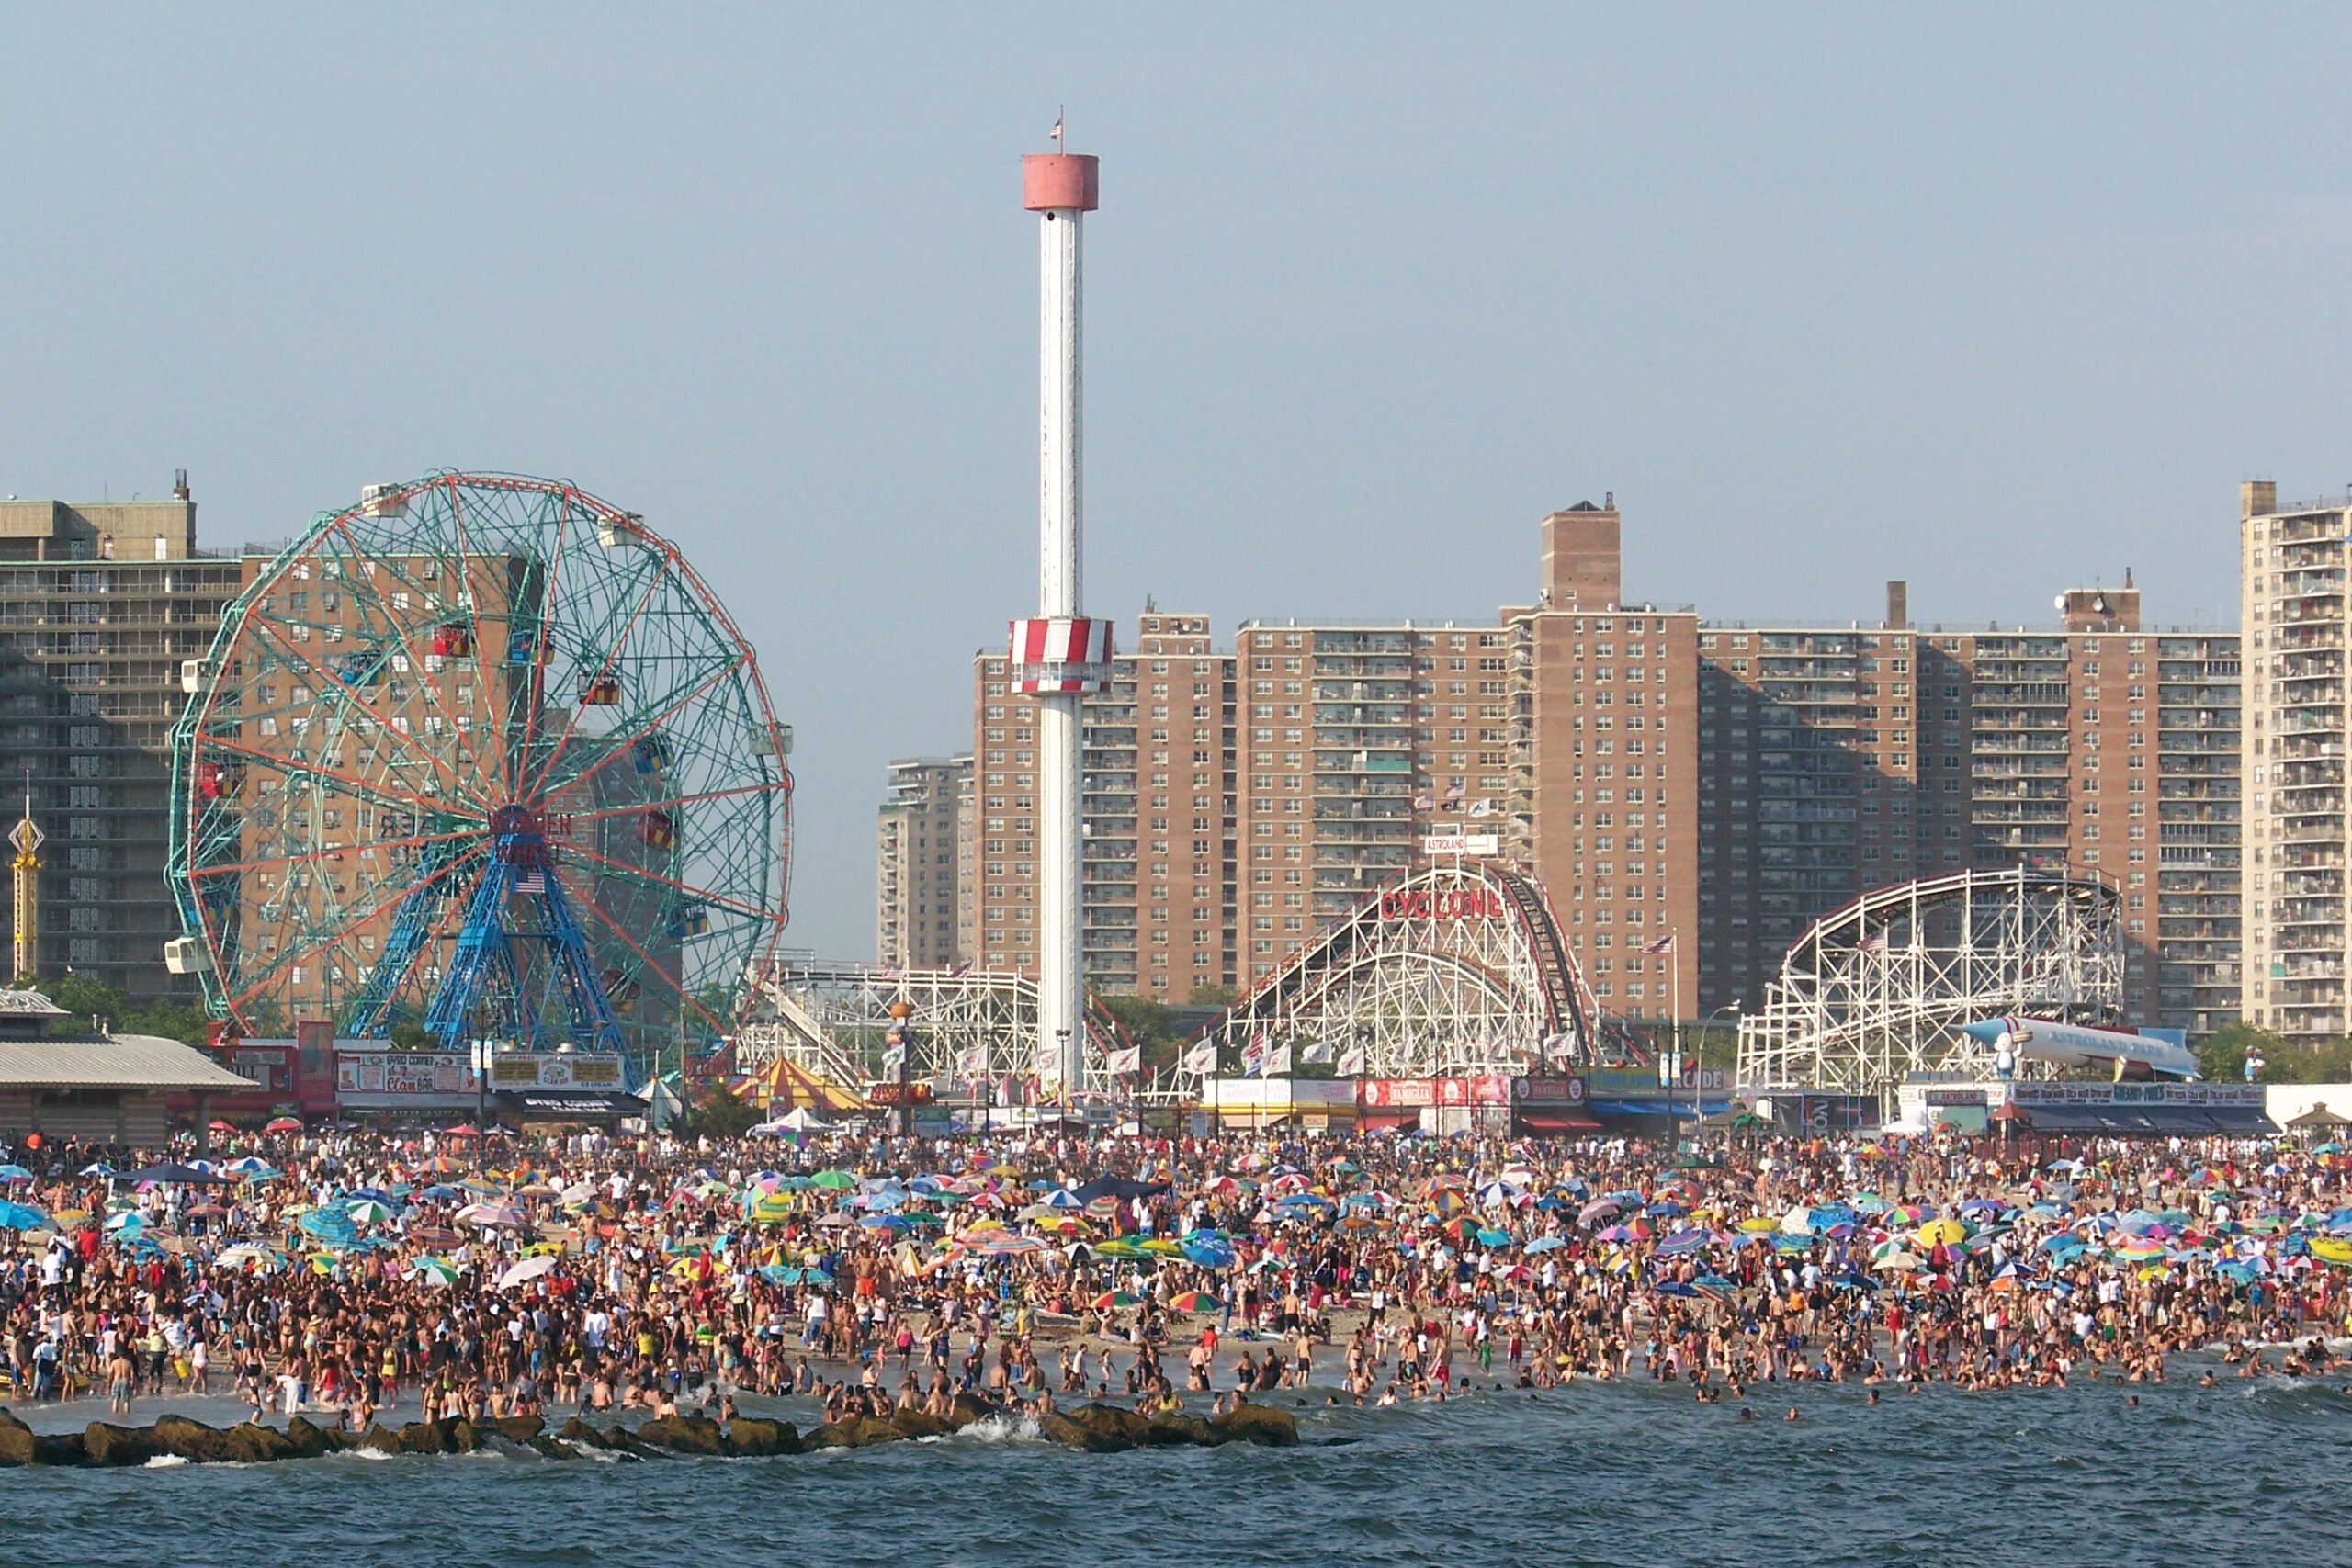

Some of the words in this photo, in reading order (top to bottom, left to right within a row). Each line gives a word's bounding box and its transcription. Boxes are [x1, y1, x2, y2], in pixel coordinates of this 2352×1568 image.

[1427, 839, 1464, 851] ASTROLAND
[1382, 888, 1504, 919] CYCLONE
[2051, 1031, 2127, 1051] ASTROLAND
[387, 1055, 407, 1066] GYRO
[1392, 1088, 1430, 1100] FAMIGLIA
